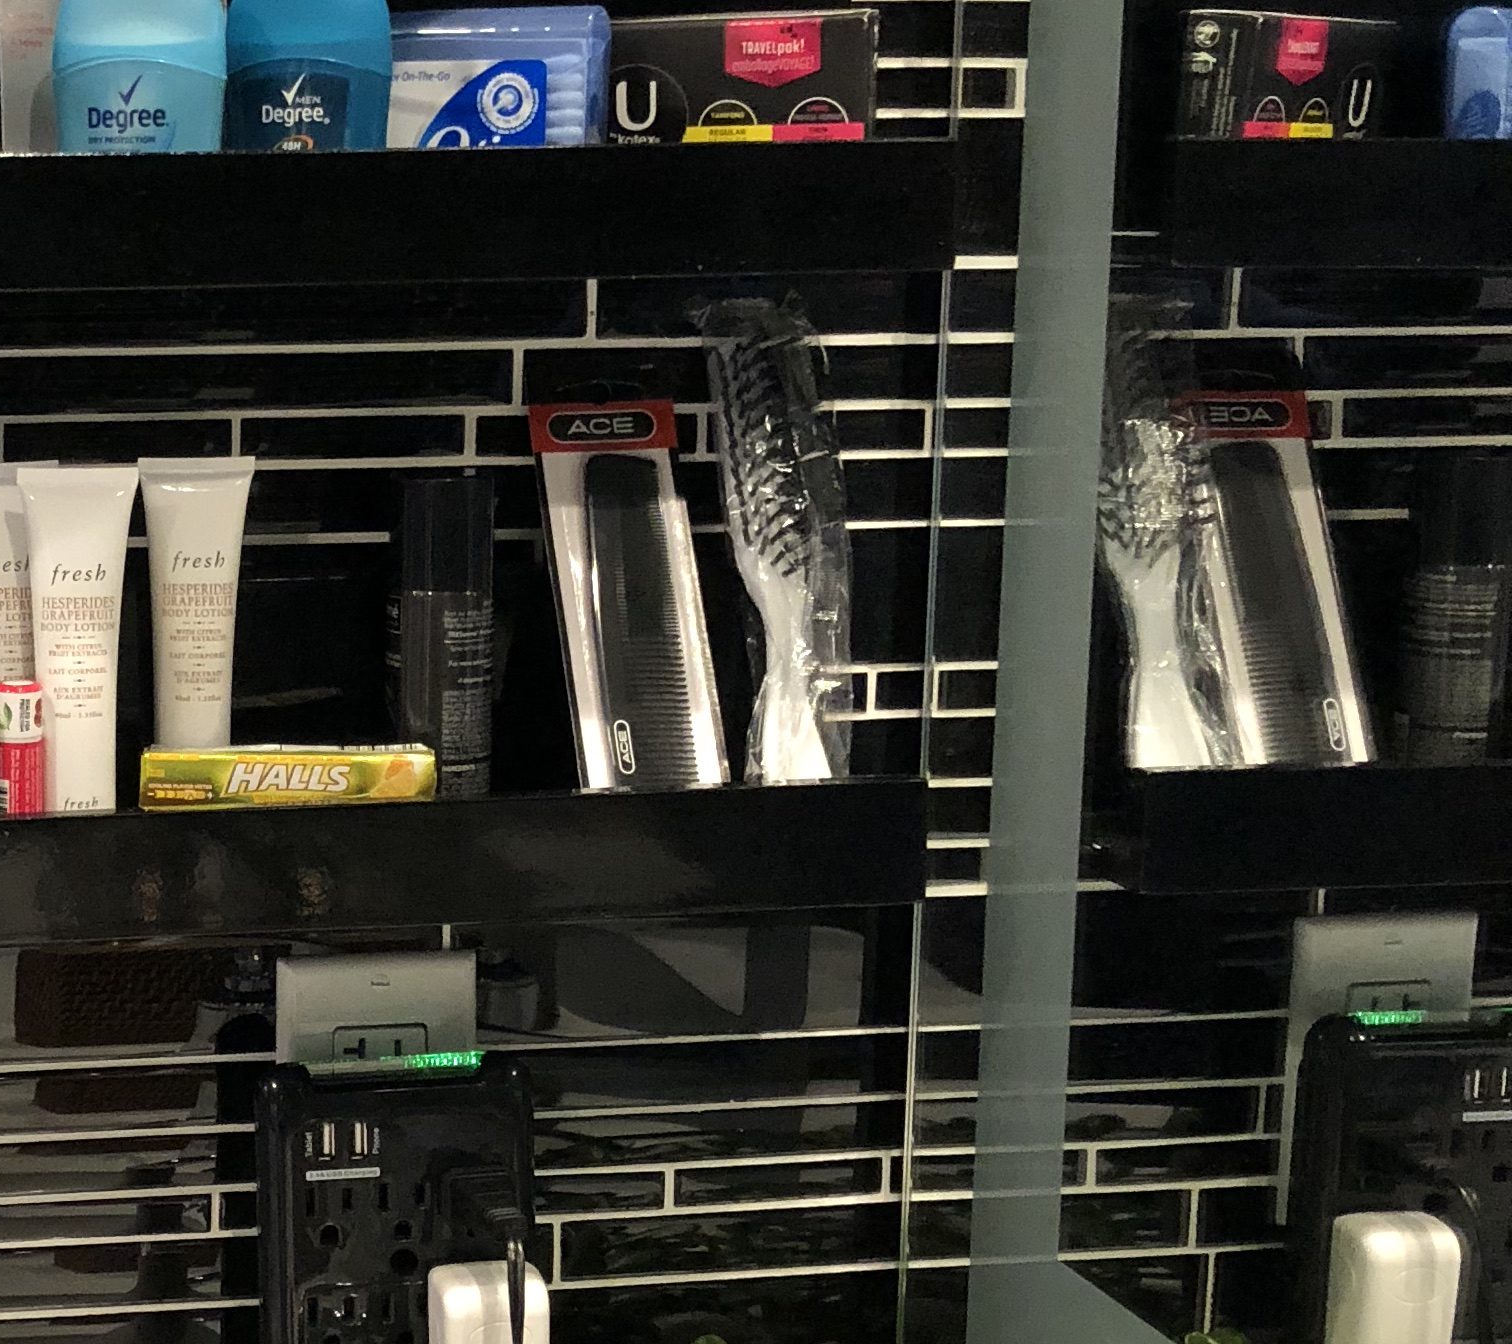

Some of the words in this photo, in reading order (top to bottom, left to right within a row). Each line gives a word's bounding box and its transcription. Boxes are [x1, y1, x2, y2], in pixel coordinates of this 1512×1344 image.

[402, 71, 451, 82] On-The-Go
[295, 95, 321, 104] MEN
[615, 80, 657, 131] U
[88, 107, 166, 133] Degree
[261, 105, 325, 127] Degree
[567, 417, 635, 435] ACE
[172, 550, 225, 573] fresh
[51, 563, 107, 586] fresh
[162, 583, 234, 596] HESPERIDES
[42, 597, 115, 609] HESPERIDES
[162, 595, 233, 607] GRAPEFRUIT
[42, 610, 114, 621] GRAPEFRUIT
[162, 608, 191, 618] BODY
[194, 608, 234, 618] LOTION
[41, 623, 70, 632] BODY
[74, 622, 115, 632] LOTION
[227, 761, 351, 794] HALLS
[63, 795, 99, 811] fresh
